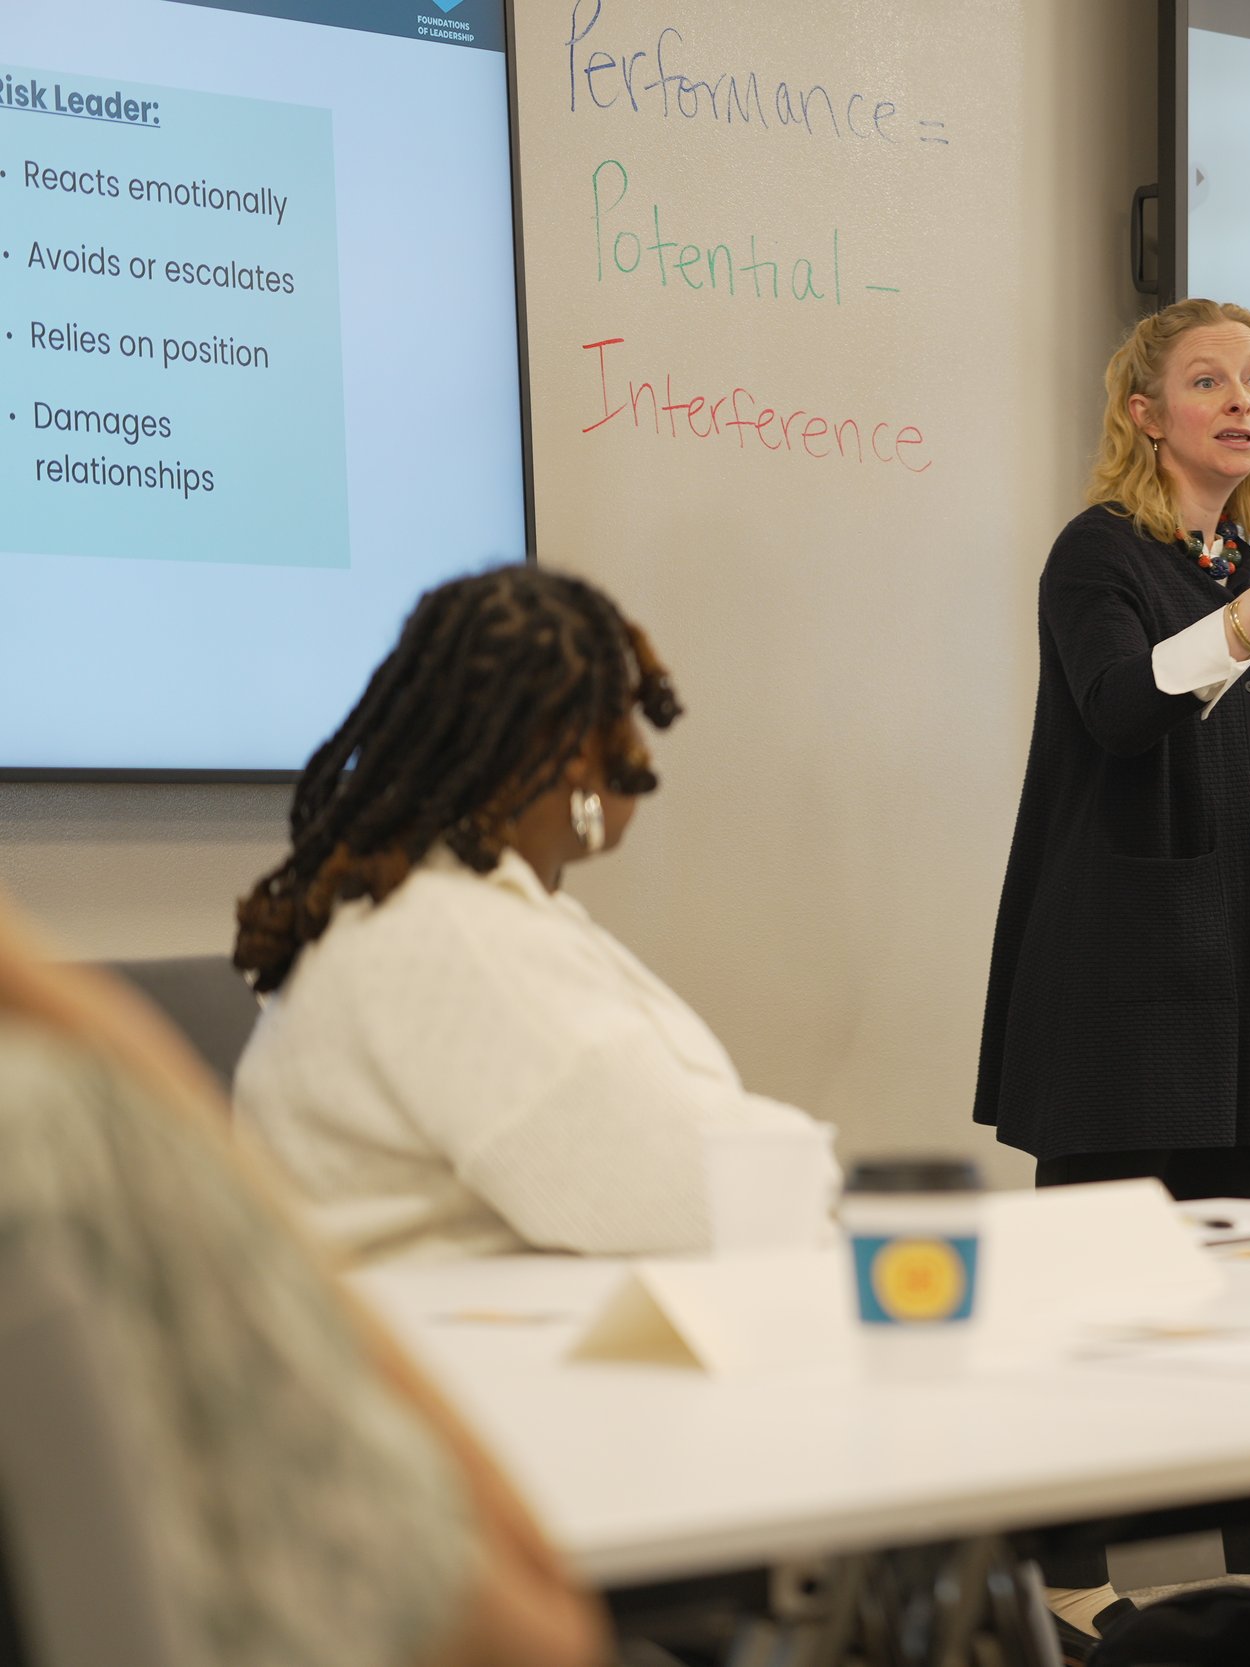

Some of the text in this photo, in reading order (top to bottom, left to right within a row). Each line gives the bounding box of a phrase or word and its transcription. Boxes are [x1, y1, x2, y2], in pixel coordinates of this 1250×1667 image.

[417, 15, 470, 31] FOUNDATIONS
[418, 27, 475, 42] OF LEADERSHIP
[564, 0, 904, 144] Performance
[0, 74, 160, 126] isk Leader:
[24, 160, 288, 226] Reacts emotionally
[590, 159, 841, 305] Potential
[27, 240, 295, 295] Avoids or escalates
[30, 321, 269, 370] Relies on position
[34, 401, 171, 446] Damages
[582, 337, 932, 472] Interference
[36, 455, 215, 500] relationships
